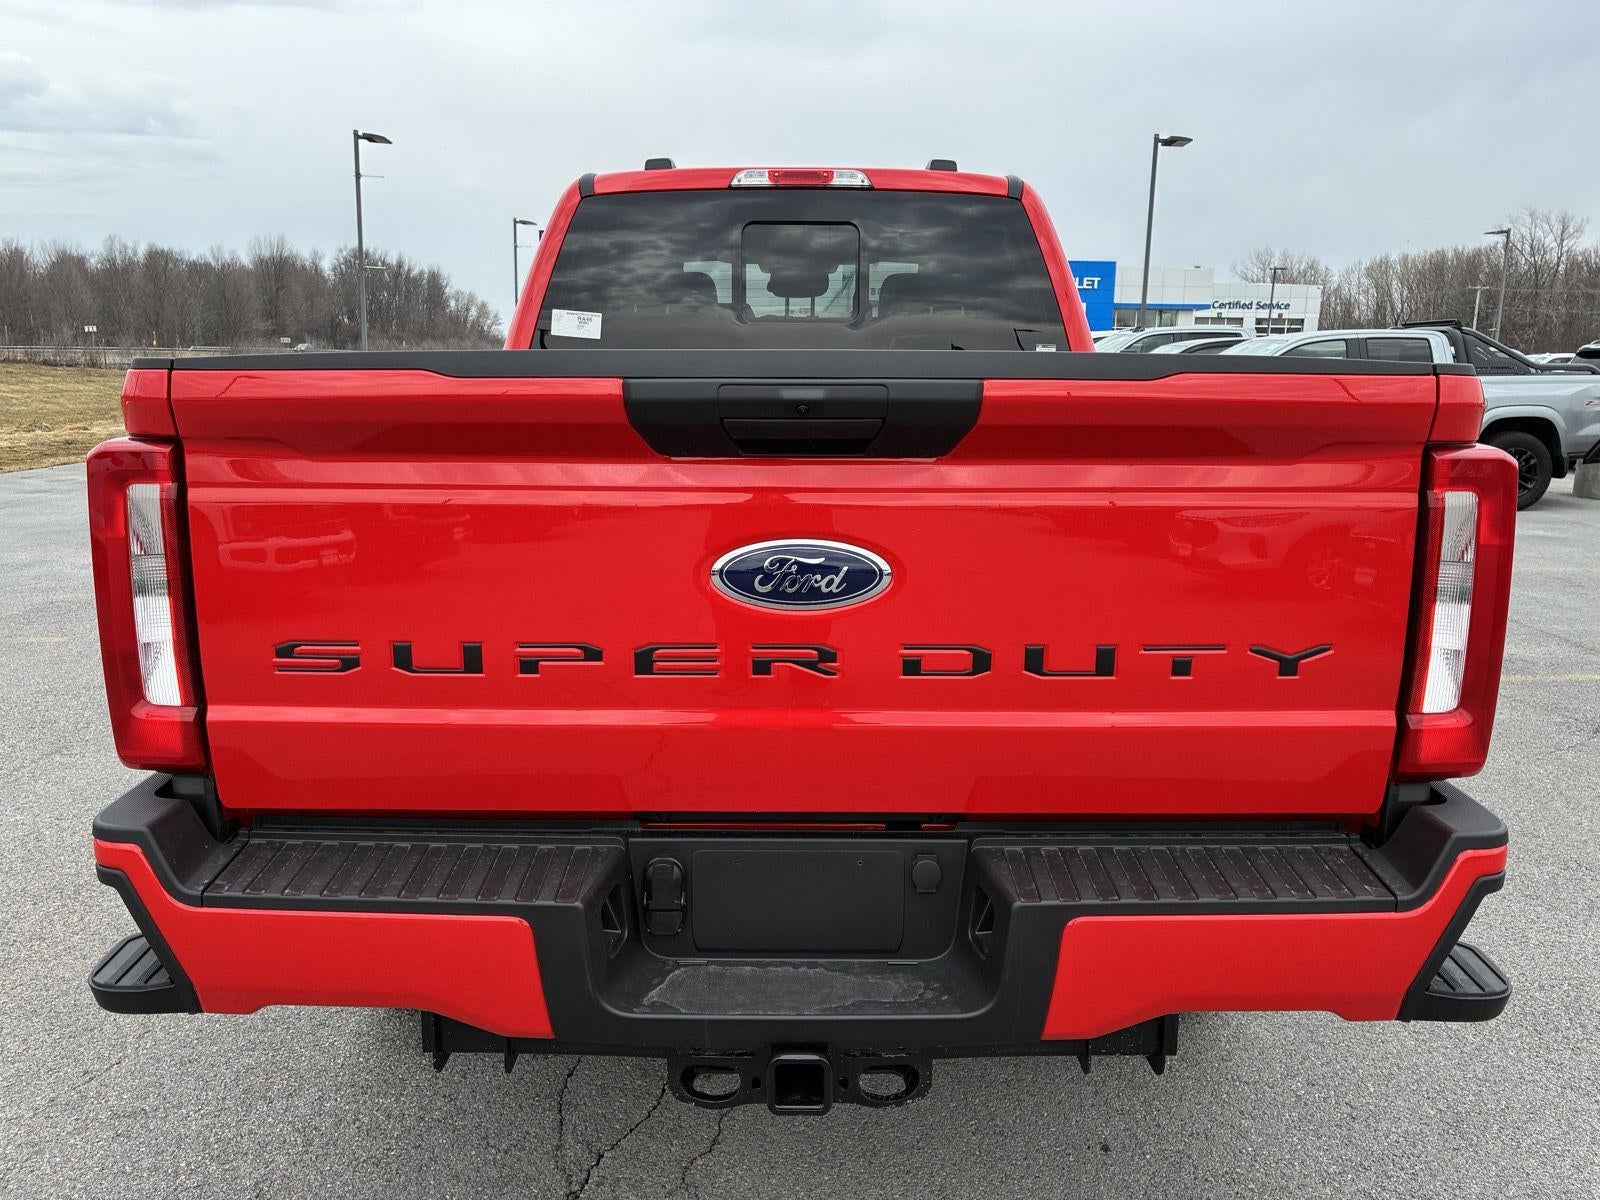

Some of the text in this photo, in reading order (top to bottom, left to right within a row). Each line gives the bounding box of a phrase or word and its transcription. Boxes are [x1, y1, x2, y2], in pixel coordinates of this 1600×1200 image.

[1212, 300, 1290, 310] Certified Service
[754, 555, 848, 593] Ford
[273, 640, 1335, 679] SUPER DUTY
